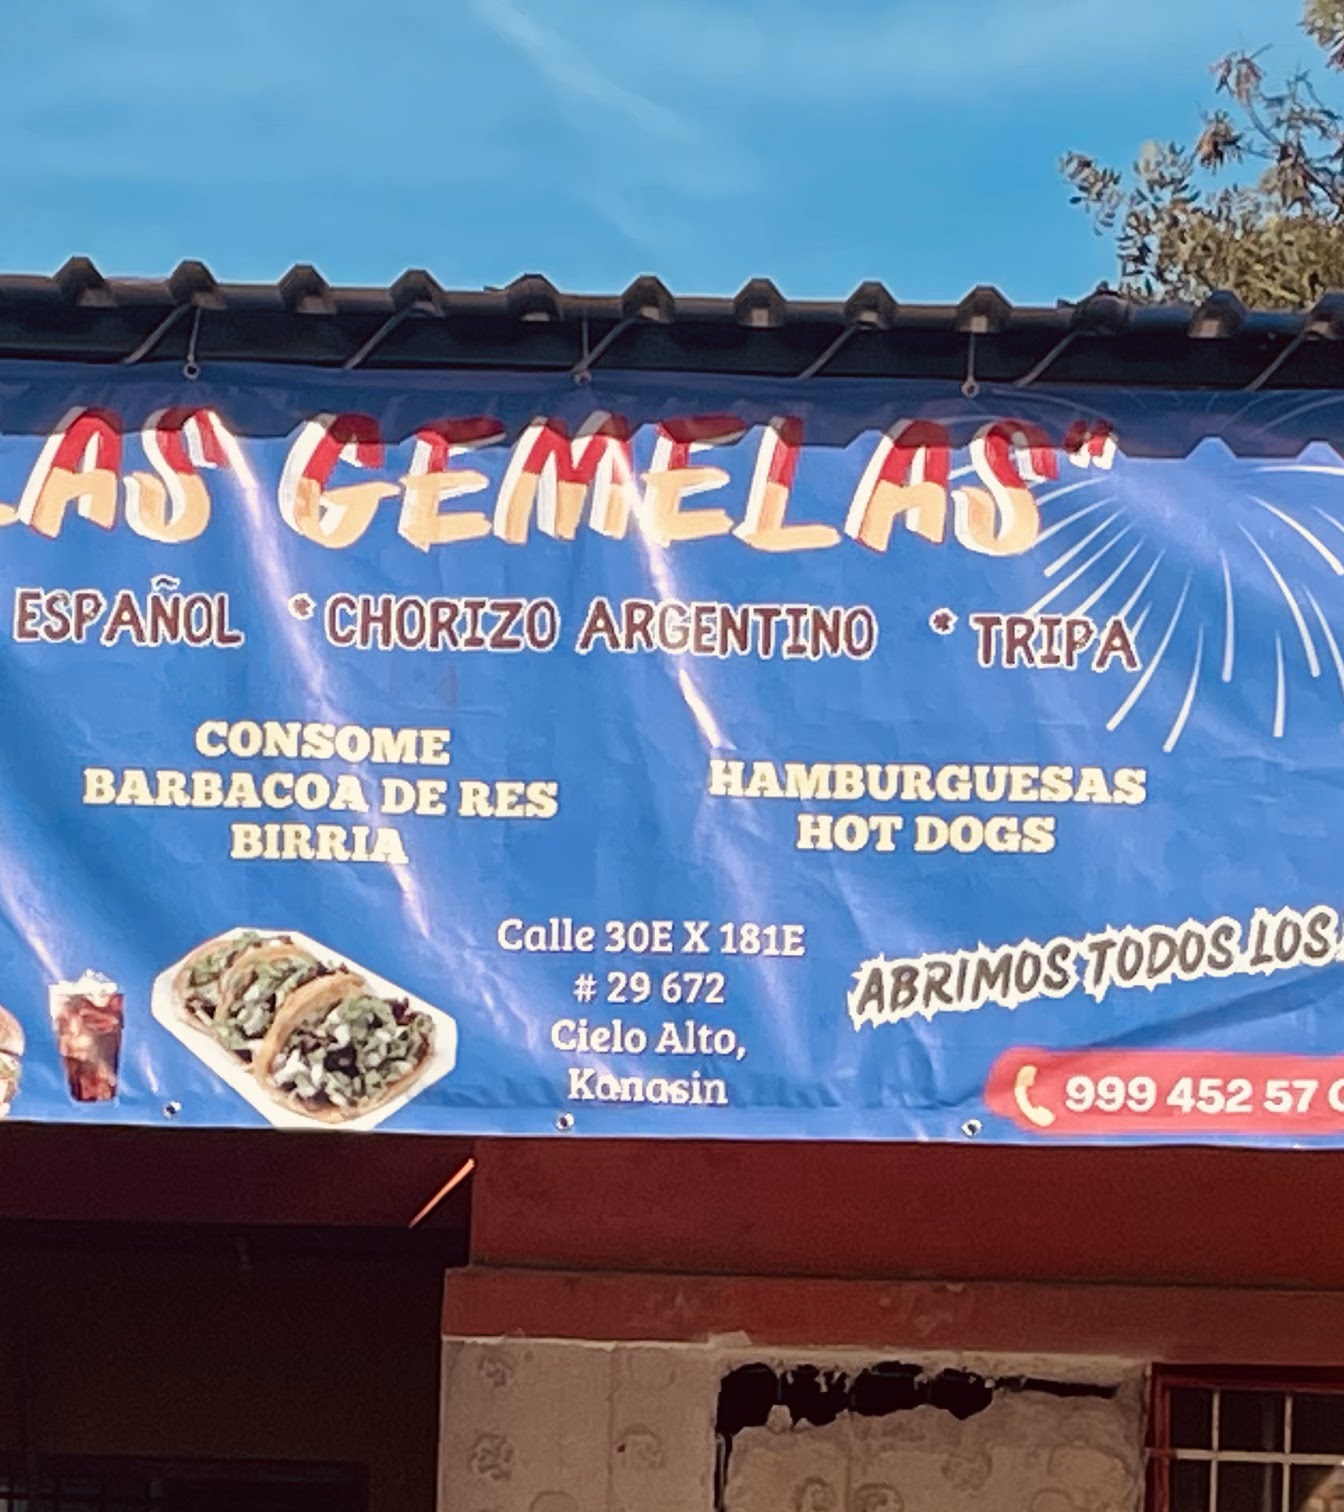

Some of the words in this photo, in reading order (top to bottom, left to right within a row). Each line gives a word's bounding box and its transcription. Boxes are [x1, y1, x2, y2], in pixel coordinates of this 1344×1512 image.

[14, 575, 244, 648] ESPAÑOL
[324, 594, 559, 653] CHORIZO
[576, 599, 878, 661] ARGENTINO
[971, 613, 1141, 674] TRIPA
[195, 720, 450, 765] CONSOME
[83, 768, 368, 814] BARBACOA
[380, 777, 448, 816] DE
[459, 781, 559, 819] RES
[710, 758, 1148, 806] HAMBURGUESAS
[230, 824, 408, 864] BIRRIA
[796, 816, 904, 853] HOT
[915, 816, 1056, 854] DOGS
[497, 918, 595, 951] Calle
[605, 920, 673, 952] 30E
[681, 920, 710, 953] X
[719, 922, 805, 956] 181E
[852, 941, 1074, 1018] ABRIMOS
[1086, 922, 1236, 988] TODOS
[1250, 908, 1333, 967] LOS
[573, 974, 597, 1003] #
[607, 972, 651, 1003] 29
[661, 972, 725, 1003] 672
[551, 1019, 646, 1053] Cielo
[655, 1021, 747, 1061] Alto,
[1065, 1075, 1156, 1112] 999
[1166, 1077, 1253, 1112] 452
[1263, 1078, 1317, 1112] 57
